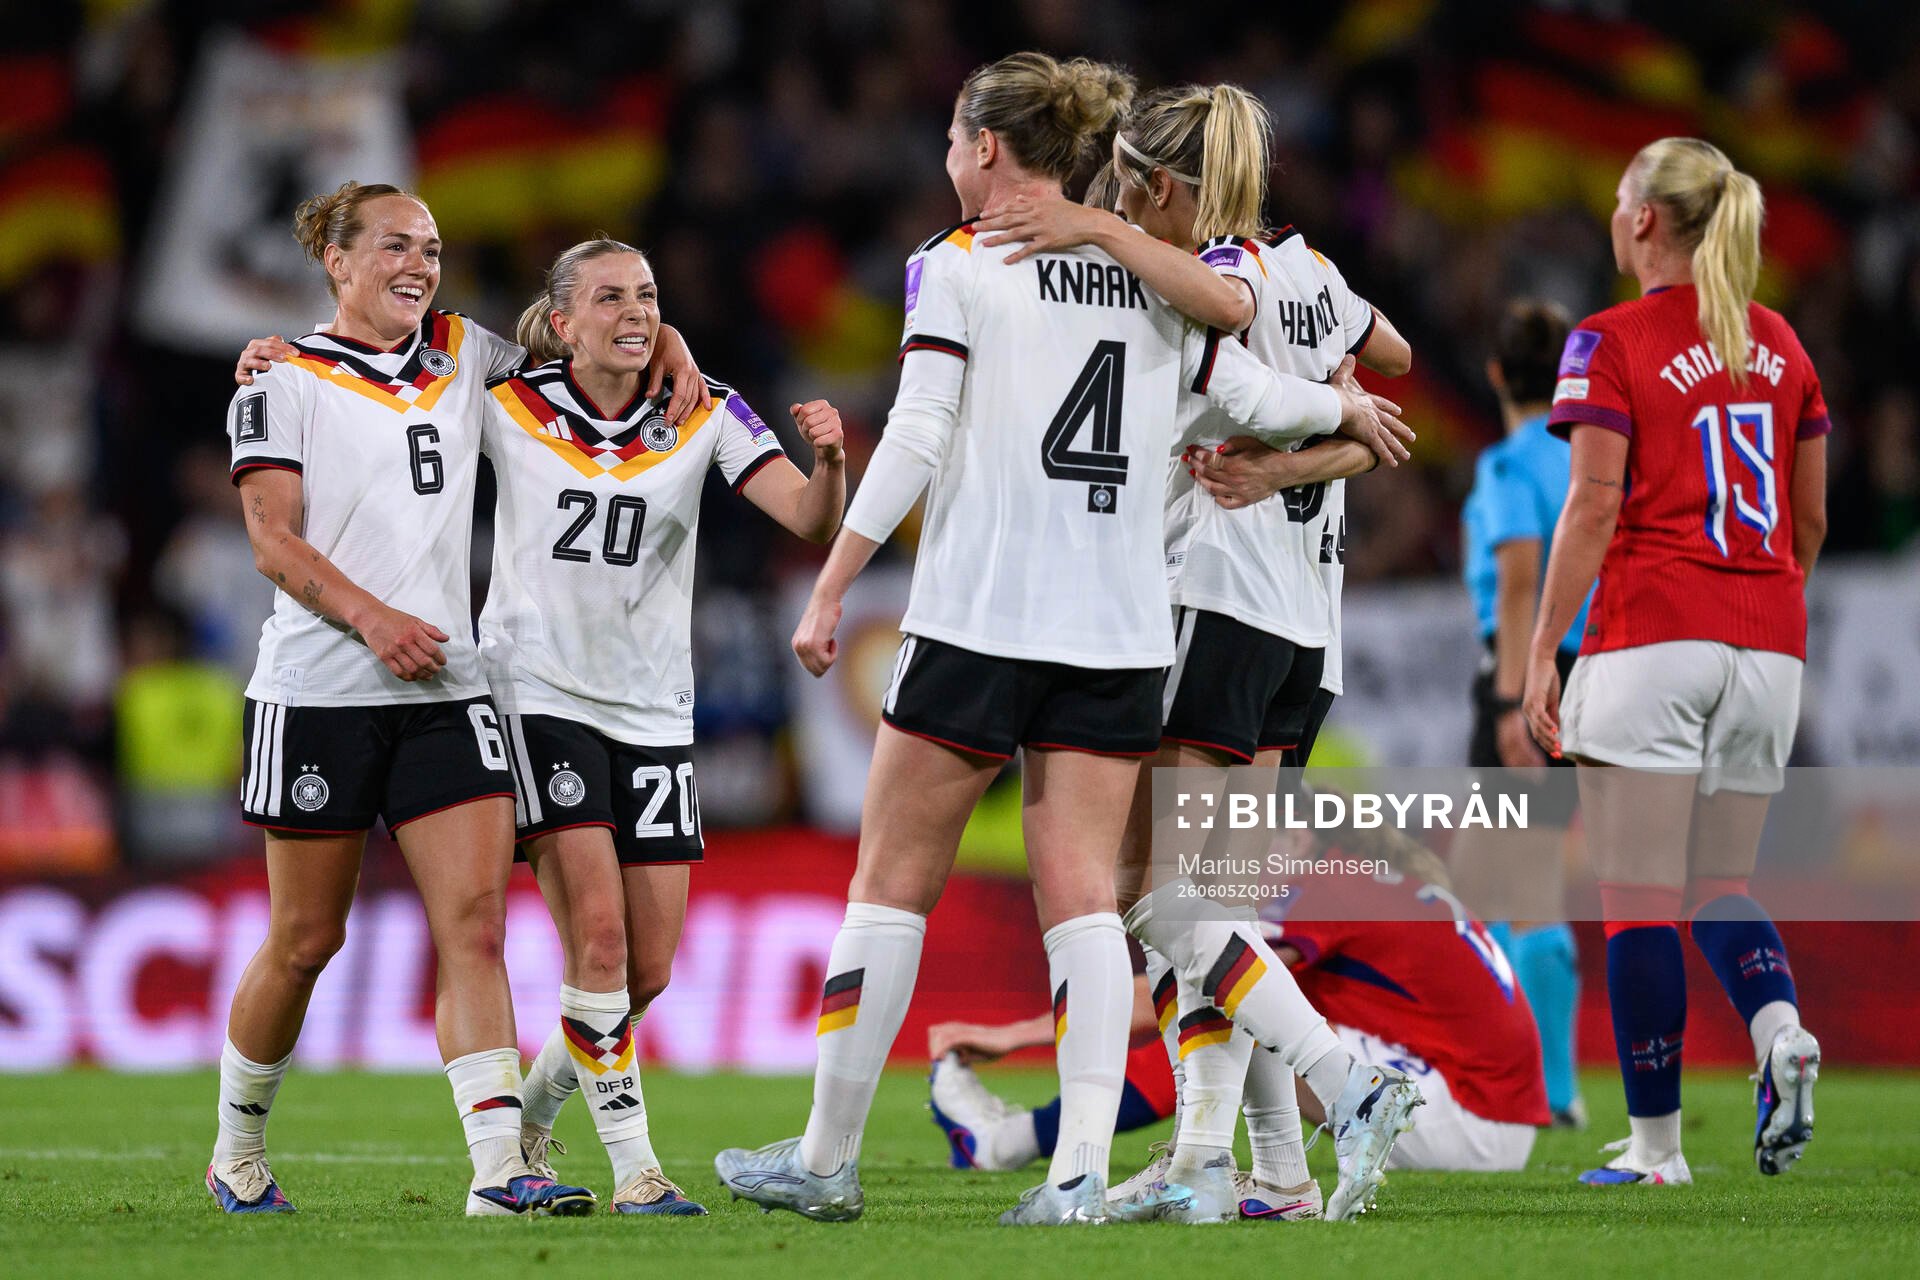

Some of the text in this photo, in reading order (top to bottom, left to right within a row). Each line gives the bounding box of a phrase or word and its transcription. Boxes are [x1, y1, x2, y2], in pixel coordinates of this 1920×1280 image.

[1036, 259, 1148, 310] KNAAK
[1041, 339, 1129, 486] 4
[406, 423, 444, 496] 6
[552, 488, 647, 567] 20
[466, 703, 508, 771] 6
[632, 762, 695, 838] 20
[595, 1076, 634, 1093] DFB
